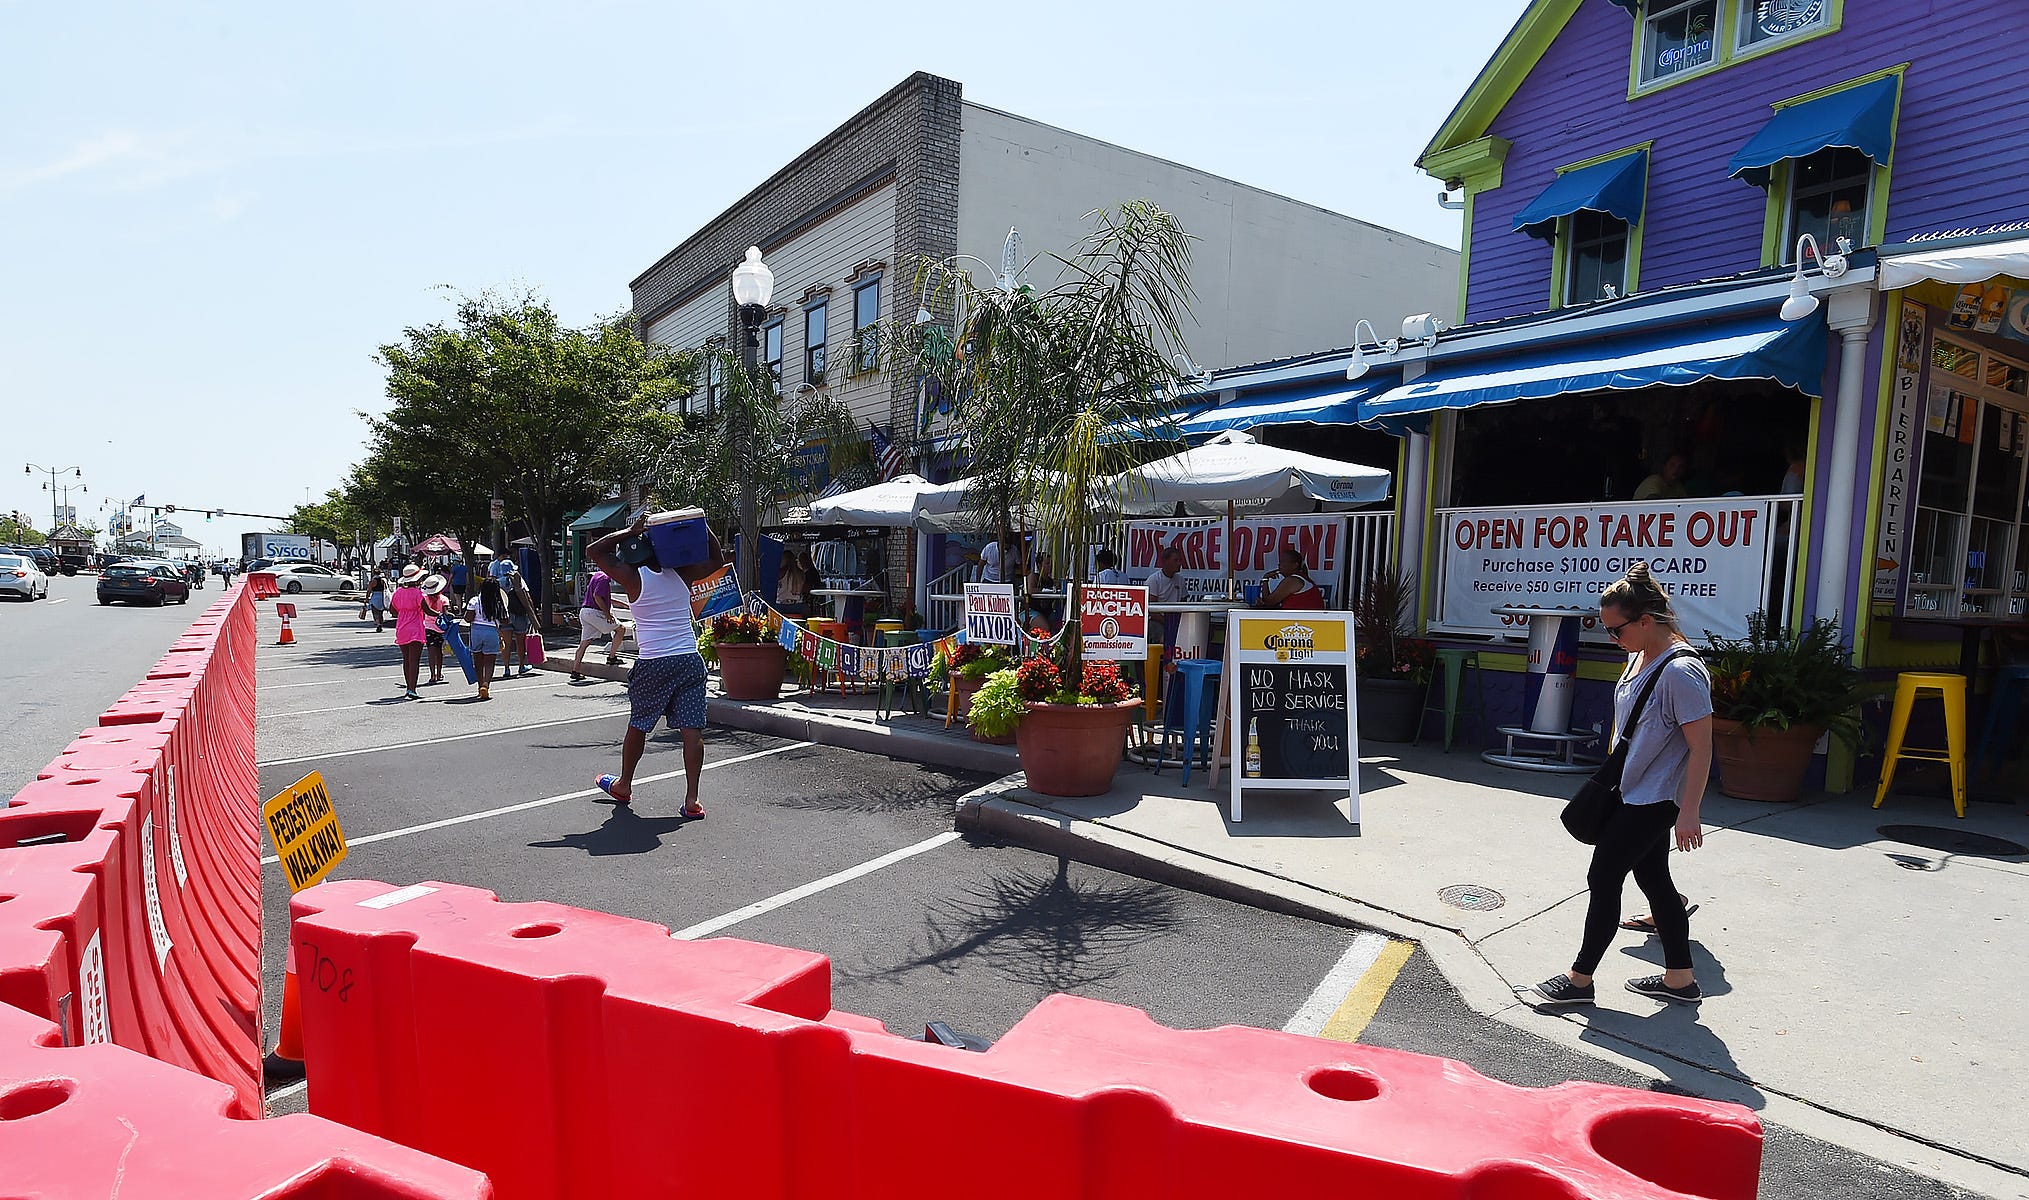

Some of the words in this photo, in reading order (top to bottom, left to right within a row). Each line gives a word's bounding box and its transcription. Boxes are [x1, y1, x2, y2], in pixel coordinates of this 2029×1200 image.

[1658, 39, 1710, 67] Corona
[1885, 376, 1913, 553] BIERGARTEN
[1330, 480, 1353, 491] Corona
[1455, 518, 1524, 550] OPEN
[1534, 516, 1588, 548] FOR
[1599, 513, 1675, 547] TAKE
[1687, 510, 1758, 547] OUT
[267, 542, 308, 558] Sysco
[1482, 558, 1554, 573] Purchase
[1560, 557, 1600, 574] $100
[1651, 558, 1707, 573] CARD
[691, 575, 733, 595] FULLER
[1473, 580, 1522, 592] Receive
[1526, 581, 1549, 594] $50
[1553, 581, 1582, 593] GIFT
[1680, 583, 1717, 597] FREE
[969, 594, 986, 612] Paul
[1086, 590, 1132, 601] RACHEL
[968, 615, 1013, 641] MAYOR
[1084, 639, 1134, 649] Commissioner
[1264, 634, 1315, 651] Corona
[1173, 646, 1200, 659] Bull
[1289, 648, 1313, 660] Light
[1250, 669, 1274, 688] NO
[1289, 669, 1334, 689] MASK
[1252, 691, 1275, 709] NO
[1285, 718, 1326, 731] THANK
[1311, 734, 1338, 751] YOU
[269, 782, 331, 849] PEDESTRIAN
[285, 820, 343, 888] WALKWAY
[302, 942, 355, 1003] 708
